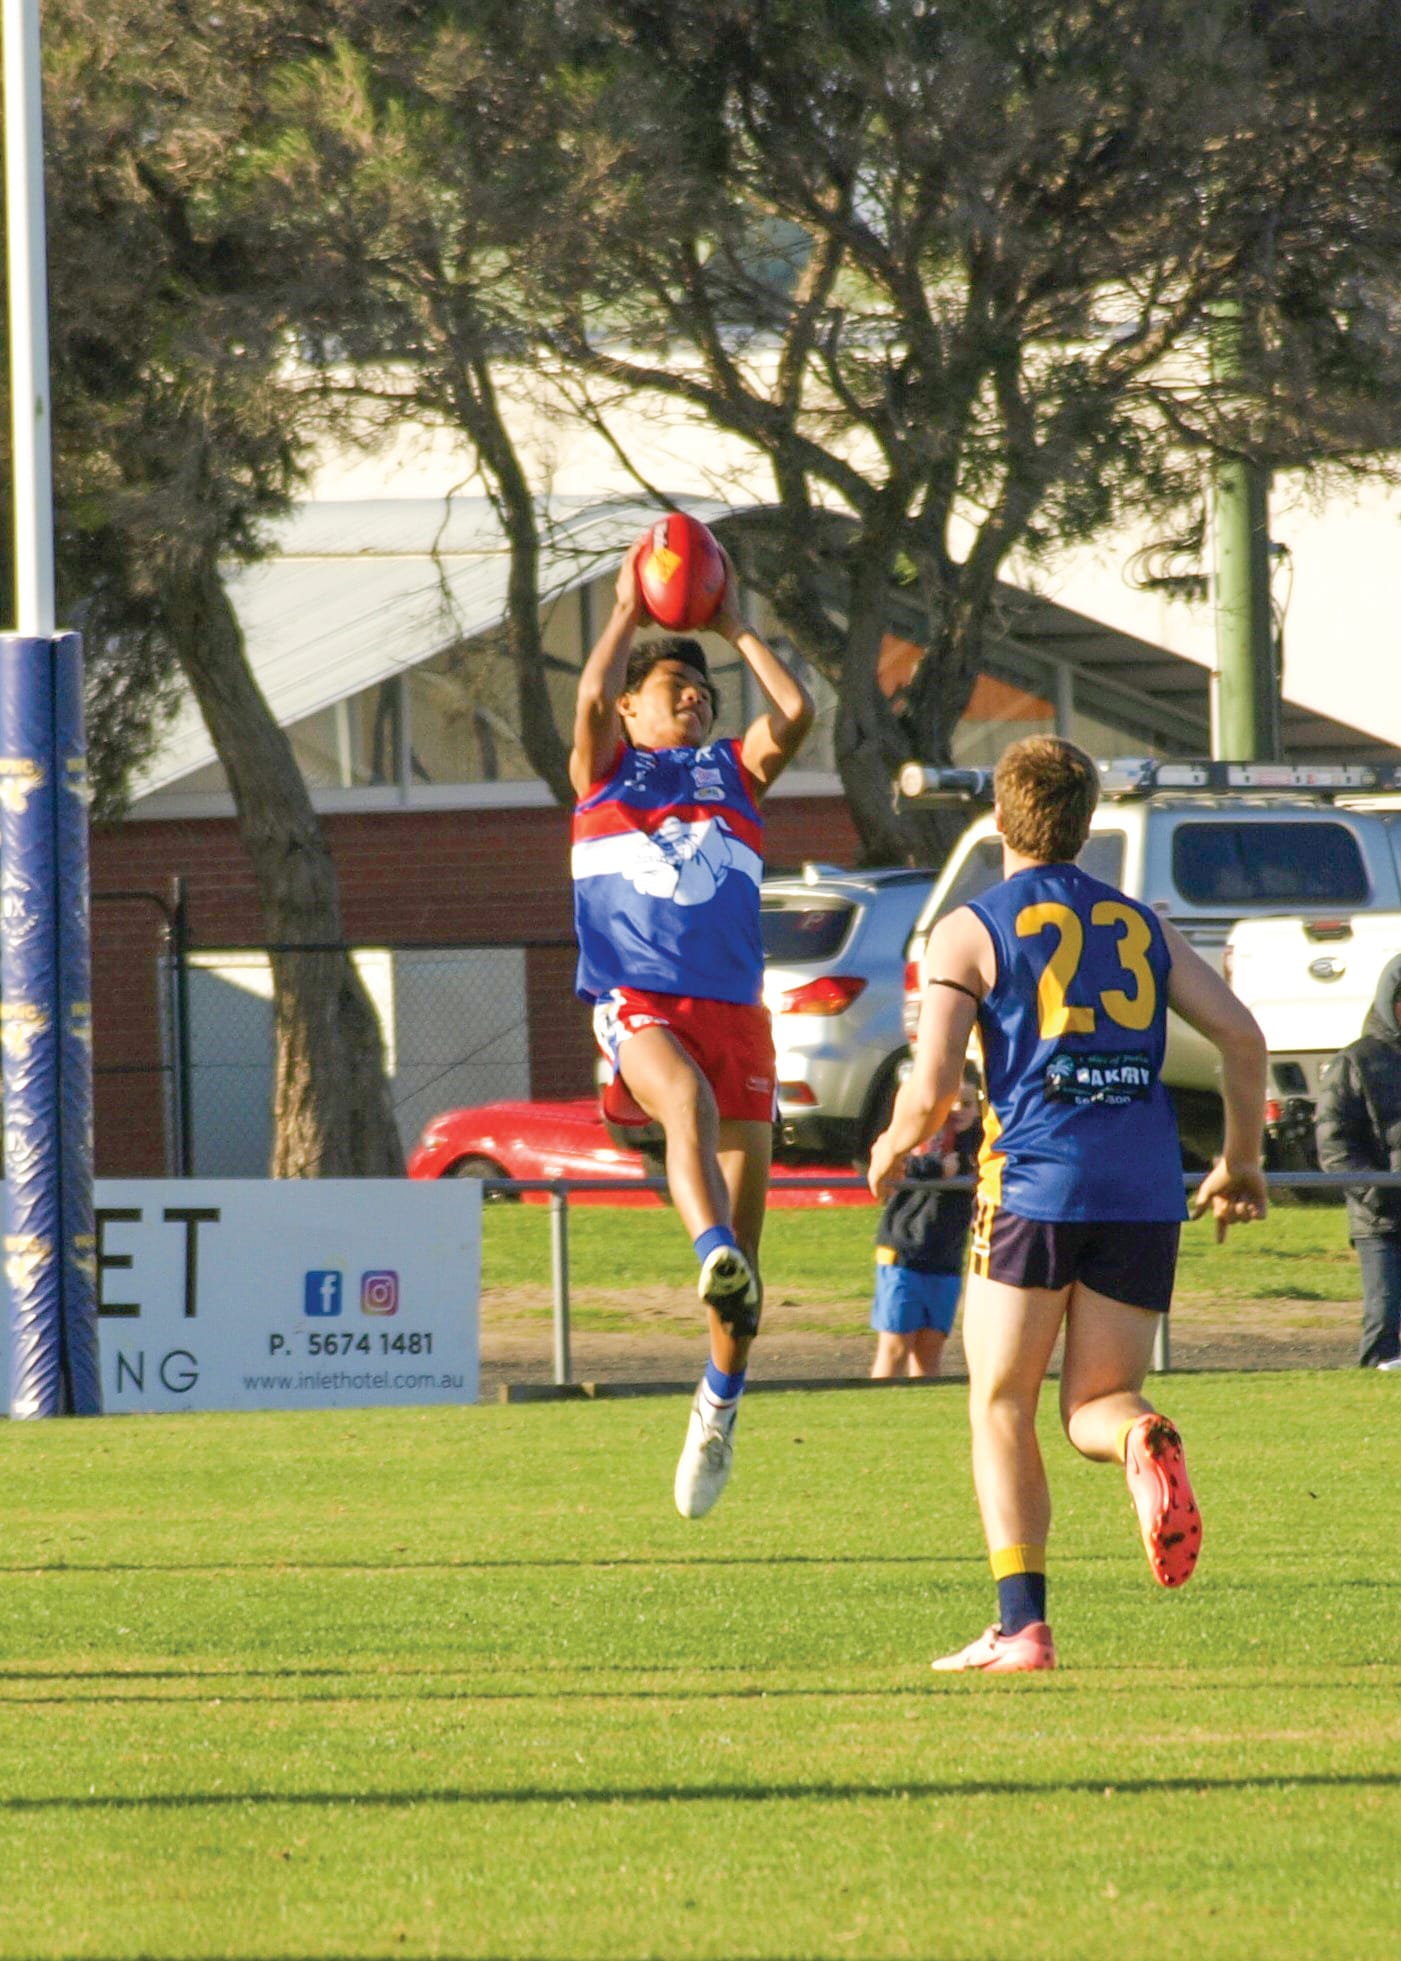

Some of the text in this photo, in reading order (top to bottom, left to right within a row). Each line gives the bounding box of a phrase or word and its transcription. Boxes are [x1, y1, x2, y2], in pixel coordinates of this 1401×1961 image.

[1015, 901, 1156, 1040] 23
[95, 1207, 221, 1318] ET
[269, 1333, 433, 1355] P. 5674 1481
[116, 1350, 198, 1393] NG
[243, 1371, 464, 1390] www.inlethotel.com.au
